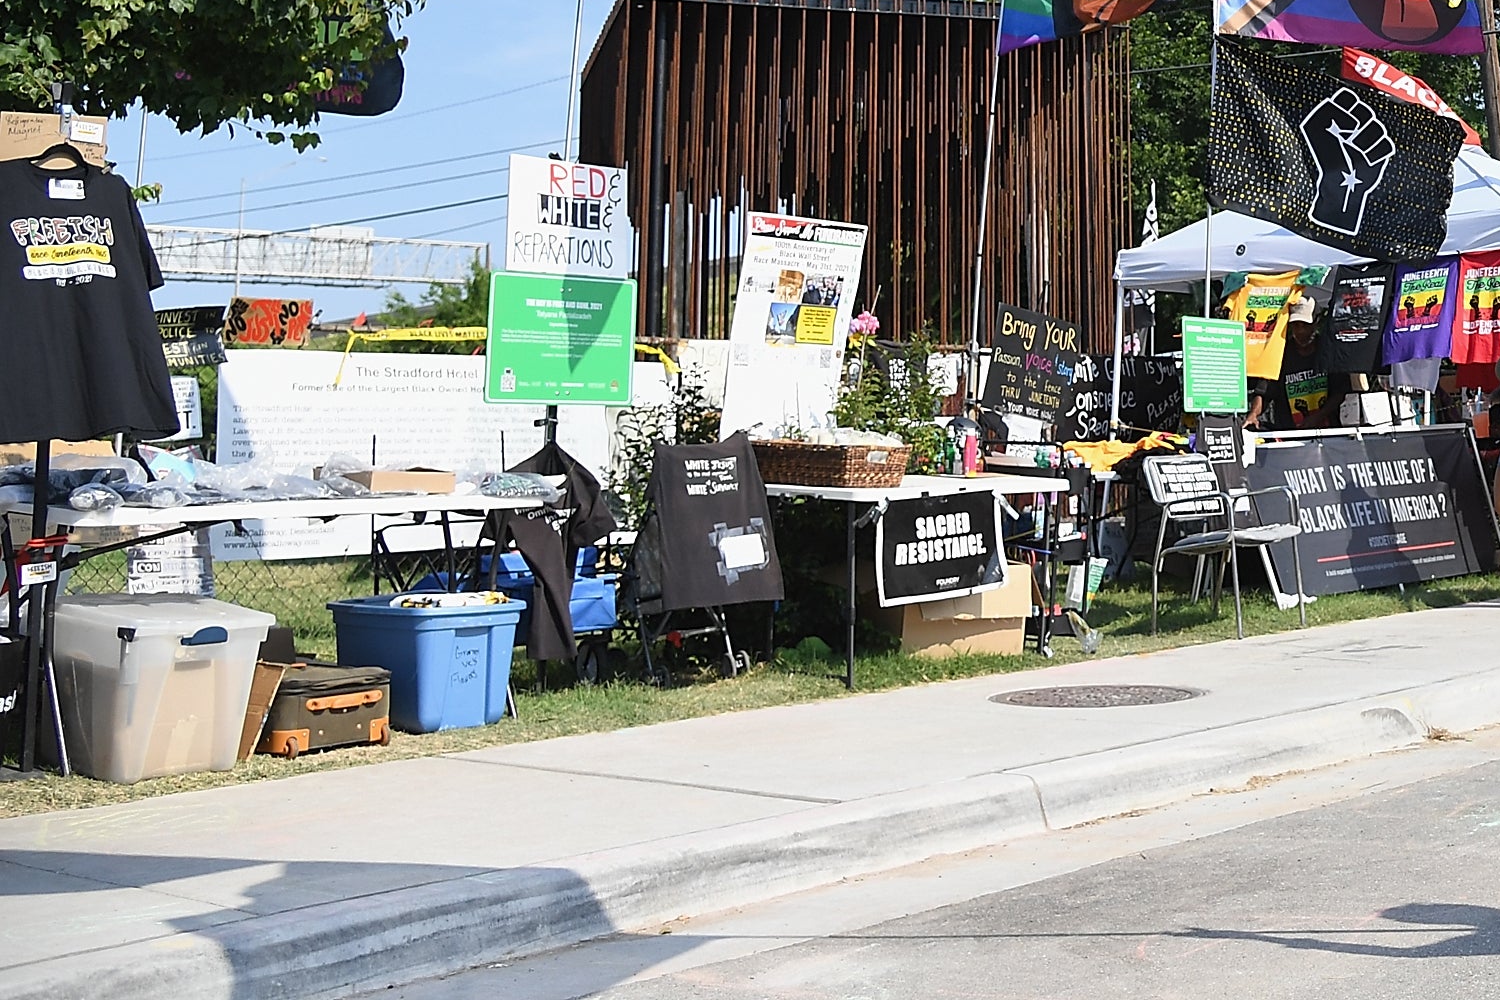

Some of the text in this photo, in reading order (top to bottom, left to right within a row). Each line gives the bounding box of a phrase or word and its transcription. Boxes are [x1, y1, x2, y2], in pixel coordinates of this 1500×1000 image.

[550, 164, 606, 198] RED
[537, 193, 601, 230] WHITE
[10, 215, 114, 246] FREEISH
[513, 231, 613, 269] REPARATIONS
[779, 250, 796, 258] Black
[793, 243, 827, 254] Anniversary
[771, 258, 800, 267] Massacre
[806, 261, 818, 270] May
[1402, 267, 1450, 282] JUNETEENTH
[278, 301, 300, 326] NO
[158, 327, 197, 340] POLICE
[435, 330, 453, 338] LIVES
[455, 330, 486, 338] MATTER
[1001, 311, 1078, 352] Bring YOUR
[162, 341, 189, 355] EST
[993, 347, 1023, 369] Passion,
[167, 353, 226, 368] MUNITIES
[1104, 357, 1136, 382] Gilt
[356, 367, 479, 380] The Stradford Hotel
[1006, 371, 1062, 395] to the fence
[292, 382, 325, 392] Former
[346, 384, 356, 393] of
[357, 384, 373, 393] the
[375, 385, 410, 396] Largest
[411, 384, 436, 393] Black
[1001, 385, 1021, 400] THRU
[1065, 390, 1137, 417] onsciece
[1147, 390, 1181, 423] PLEASE
[684, 459, 710, 471] WHITE
[1284, 457, 1438, 496] WHAT IS THE VALUE OF A
[1300, 503, 1348, 534] BLACK
[1344, 500, 1376, 527] LIFE
[1375, 498, 1391, 524] IN
[1390, 494, 1440, 523] AMERICA
[915, 512, 971, 540] SACRED
[895, 533, 987, 566] RESISTANCE.
[936, 576, 960, 586] FOUNDRY
